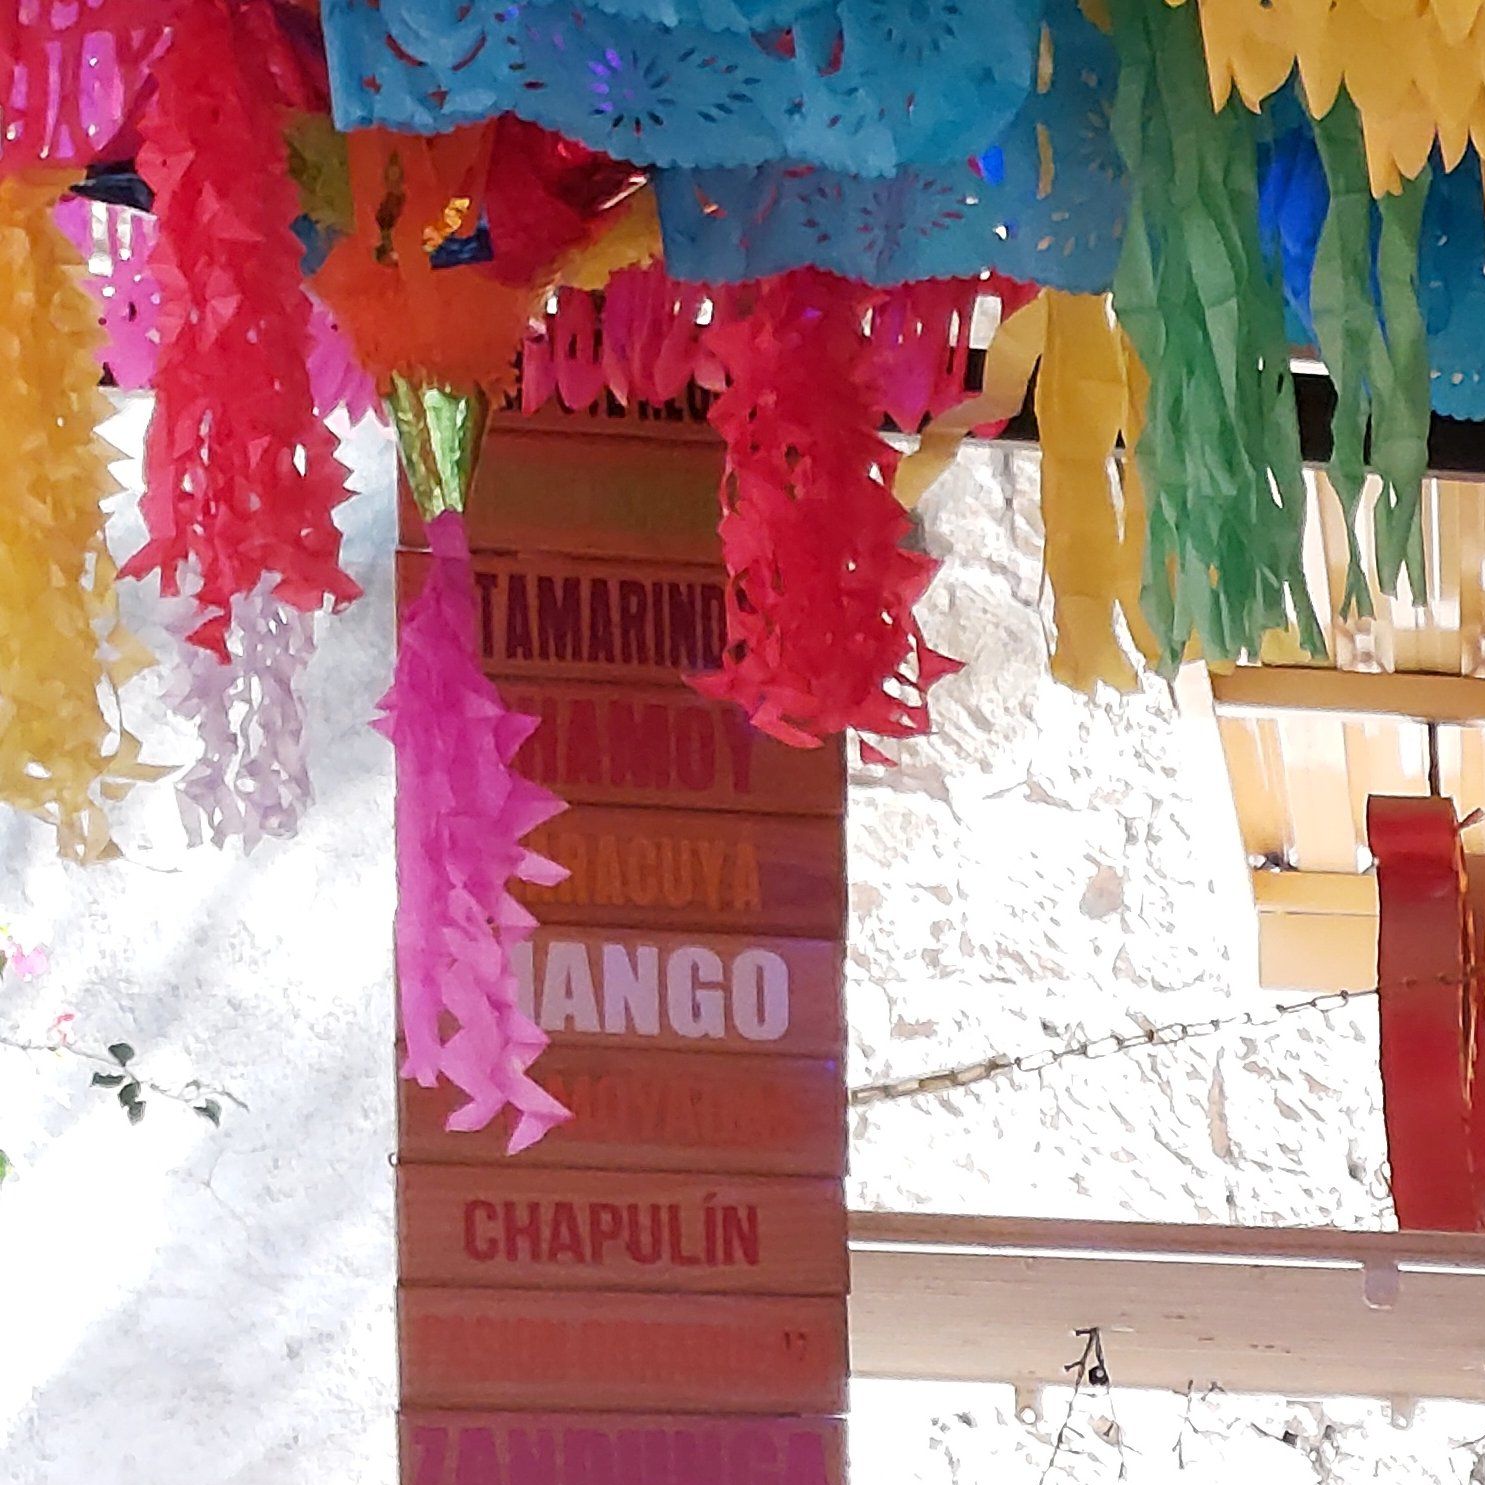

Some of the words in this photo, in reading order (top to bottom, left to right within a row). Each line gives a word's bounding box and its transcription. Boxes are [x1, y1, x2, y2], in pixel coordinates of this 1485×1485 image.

[476, 573, 729, 669] TAMARIND
[518, 699, 756, 793] HAMOY
[511, 941, 790, 1042] ANGO
[464, 1194, 760, 1266] CHAPULÍN
